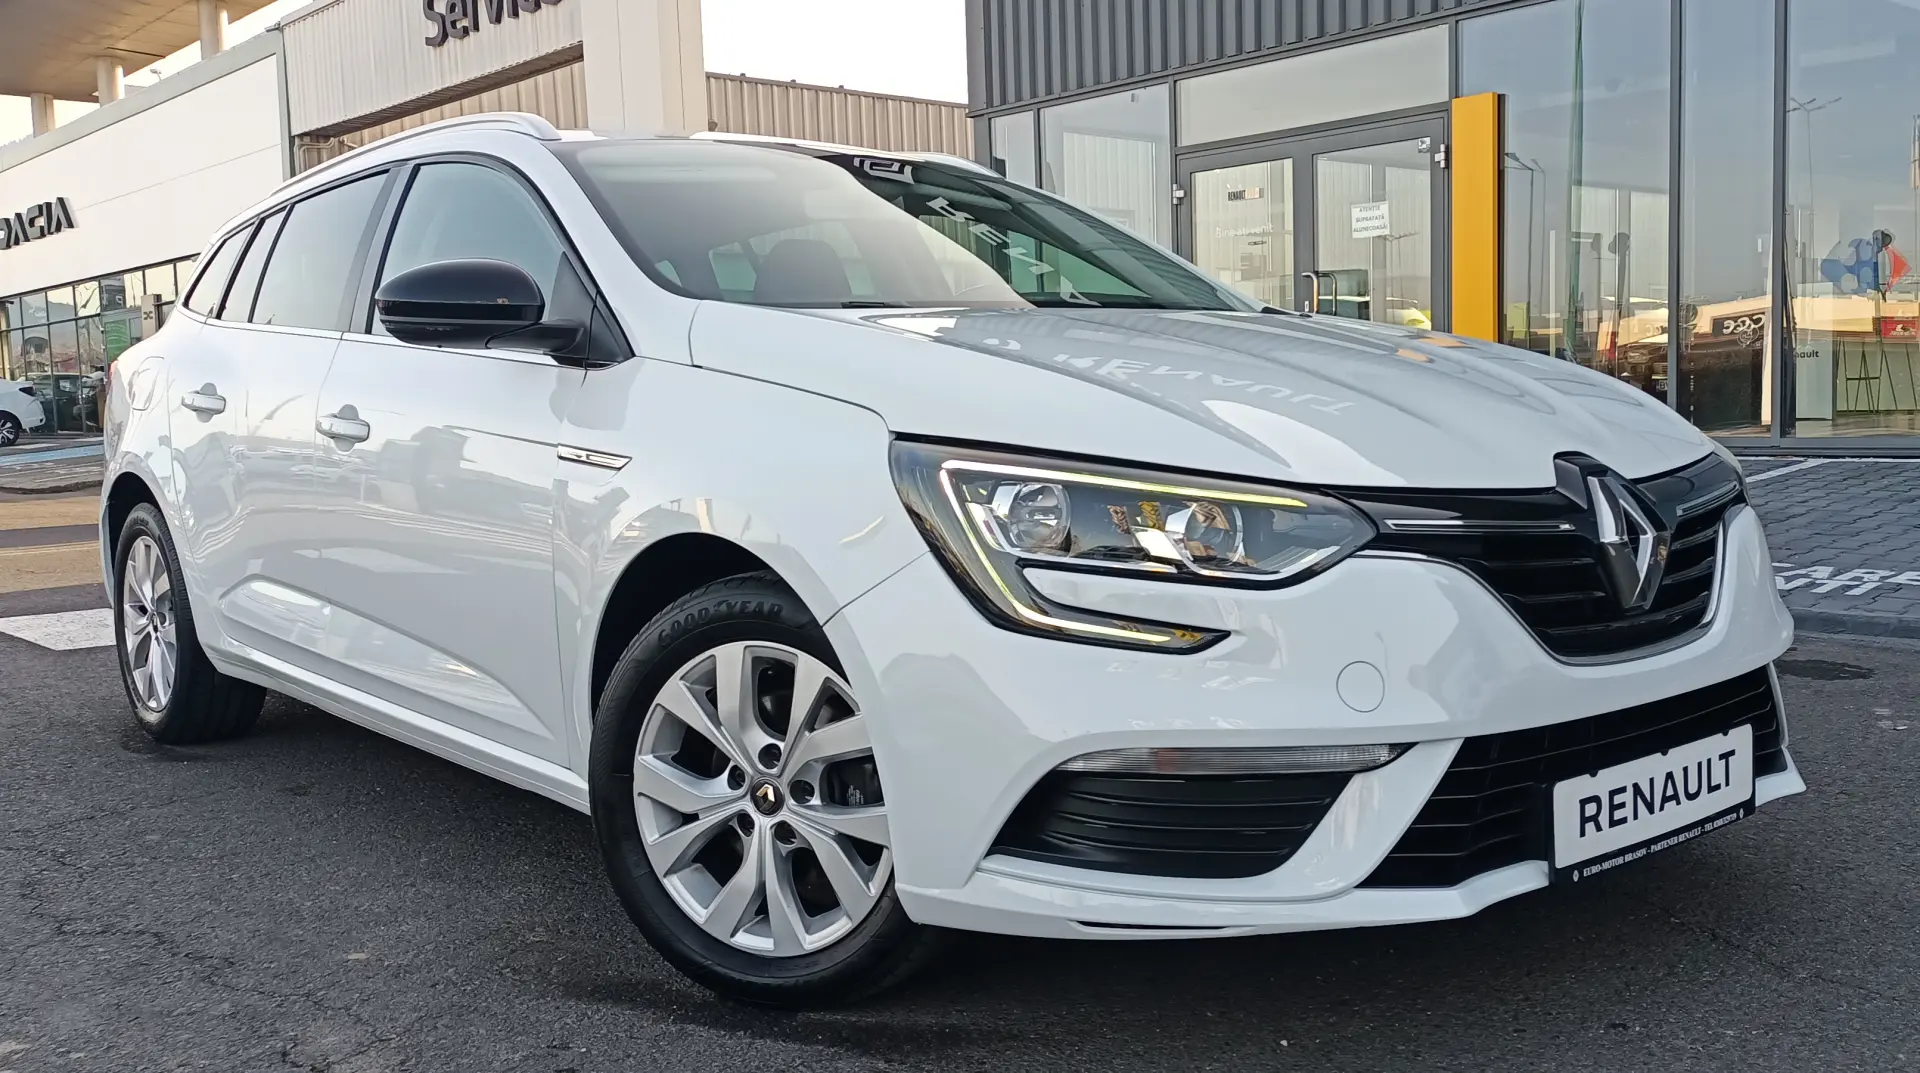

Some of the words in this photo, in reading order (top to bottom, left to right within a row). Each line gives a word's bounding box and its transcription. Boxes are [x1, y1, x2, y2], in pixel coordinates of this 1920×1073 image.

[423, 0, 561, 47] Serv
[658, 599, 784, 645] GOODYEAR
[1578, 748, 1736, 839] RENAULT
